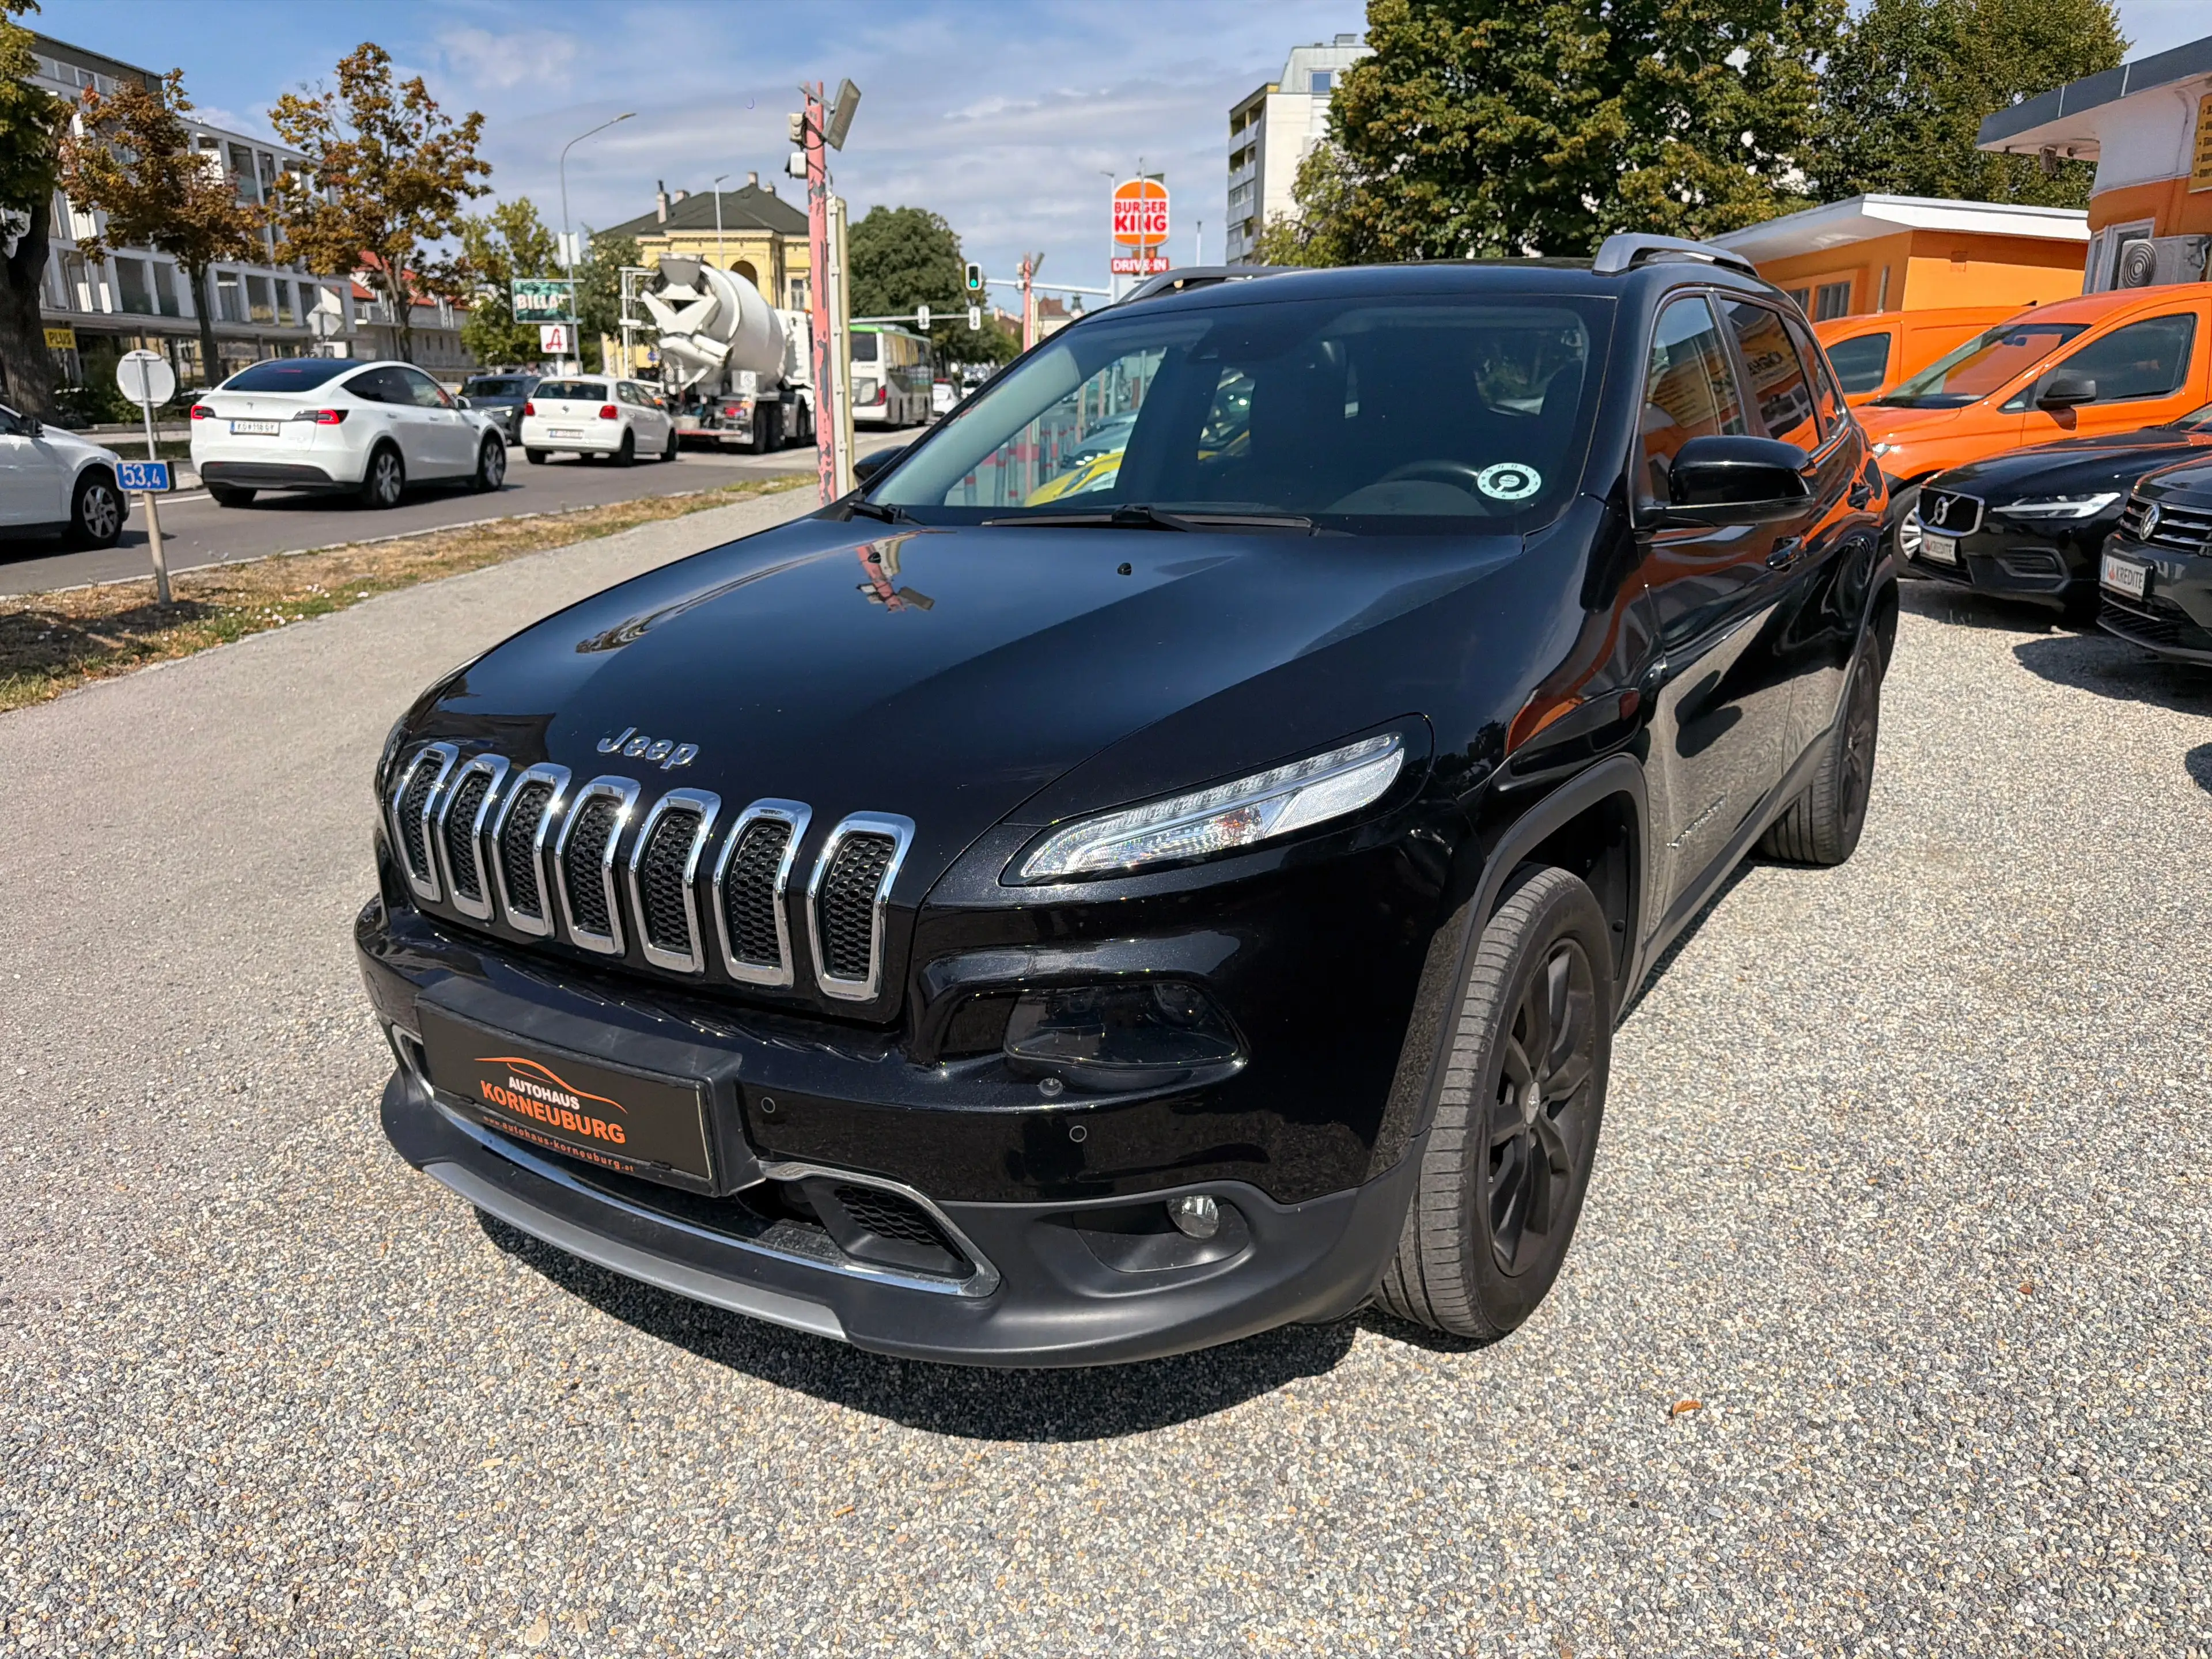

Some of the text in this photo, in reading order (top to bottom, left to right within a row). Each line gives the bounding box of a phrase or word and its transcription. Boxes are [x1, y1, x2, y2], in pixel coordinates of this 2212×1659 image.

[1115, 202, 1166, 214] BURGER
[1115, 215, 1166, 232] KING
[2116, 565, 2143, 589] KREDITE
[597, 726, 699, 770] Jeep
[509, 1076, 580, 1110] AUTOHAUS
[480, 1080, 626, 1144] KORNEUBURG
